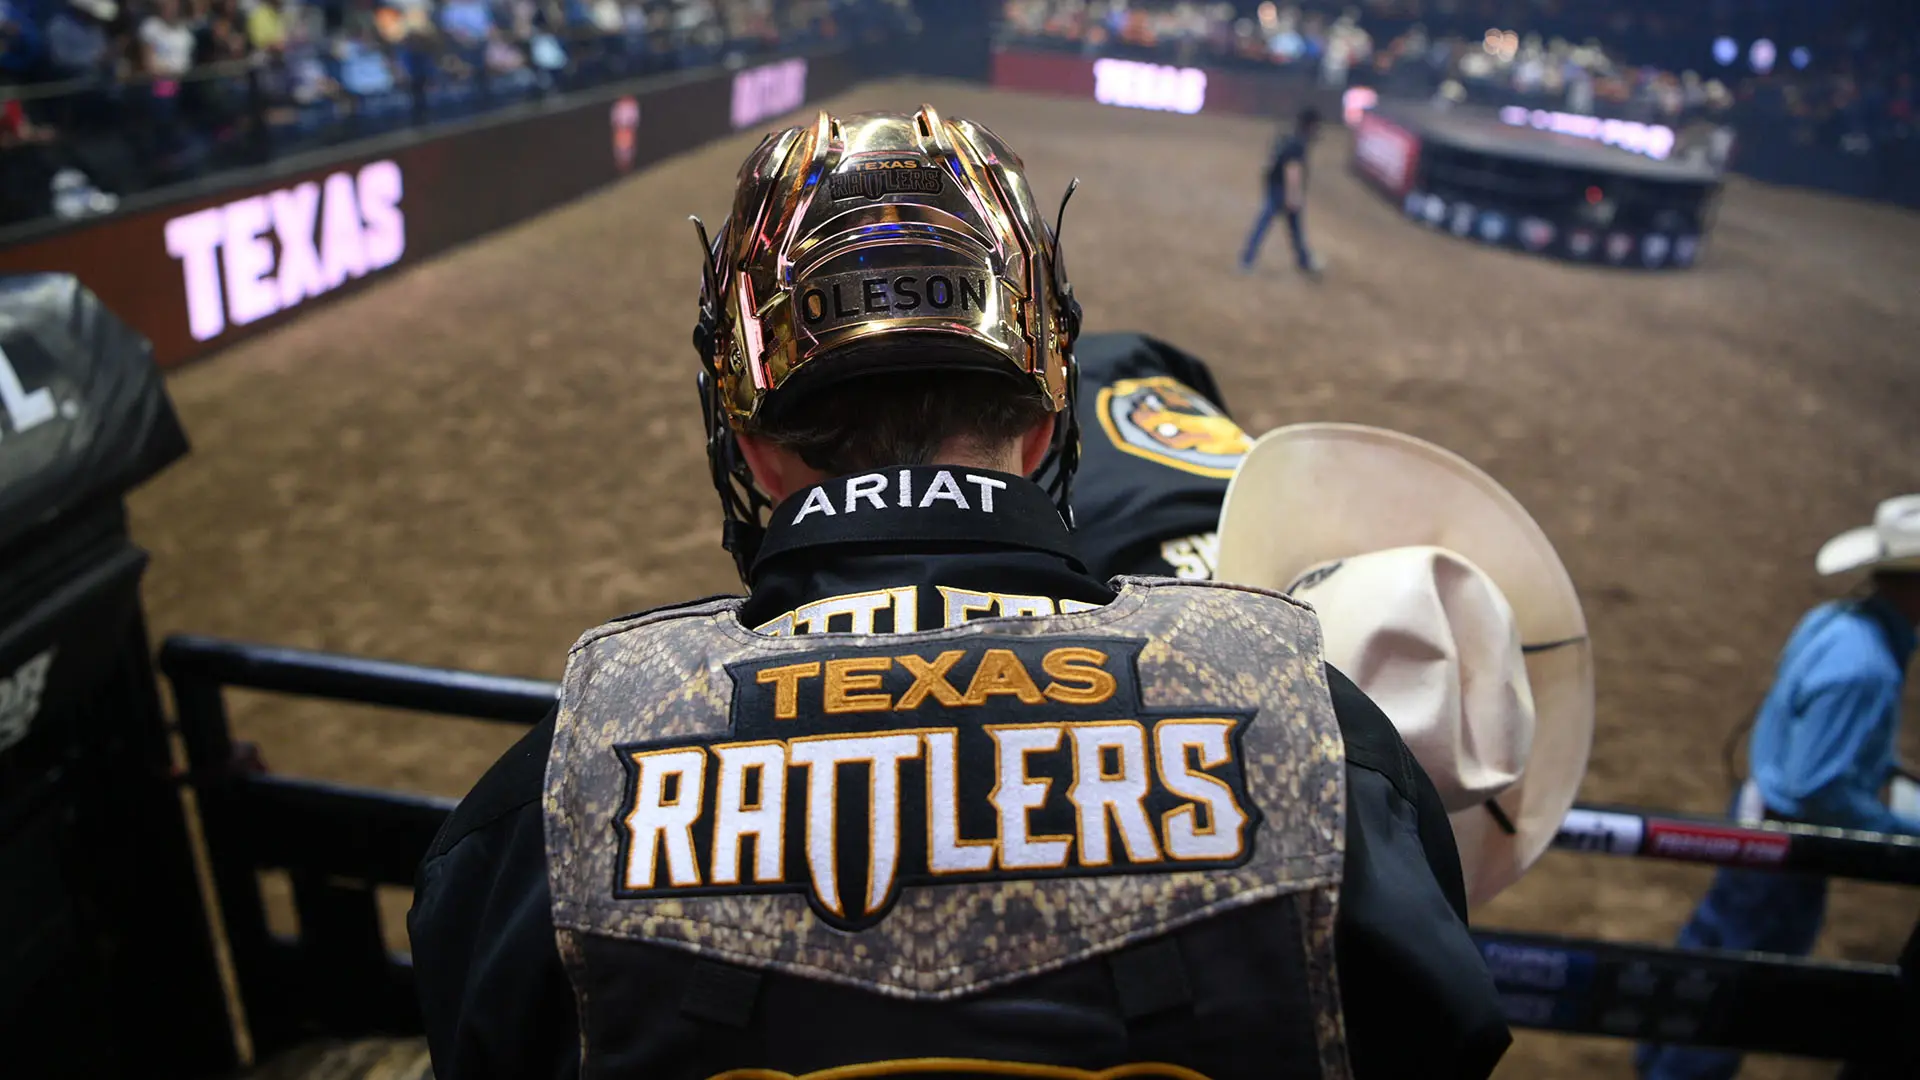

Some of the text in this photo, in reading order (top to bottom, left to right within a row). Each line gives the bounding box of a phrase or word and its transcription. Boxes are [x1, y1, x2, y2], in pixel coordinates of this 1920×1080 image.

[831, 169, 942, 197] RATTLERS
[855, 161, 917, 171] TEXAS
[165, 159, 405, 341] TEXAS
[802, 275, 987, 325] OLESON
[792, 469, 1007, 525] ARIAT
[756, 647, 1117, 719] TEXAS
[624, 718, 1249, 917] RATTLERS
